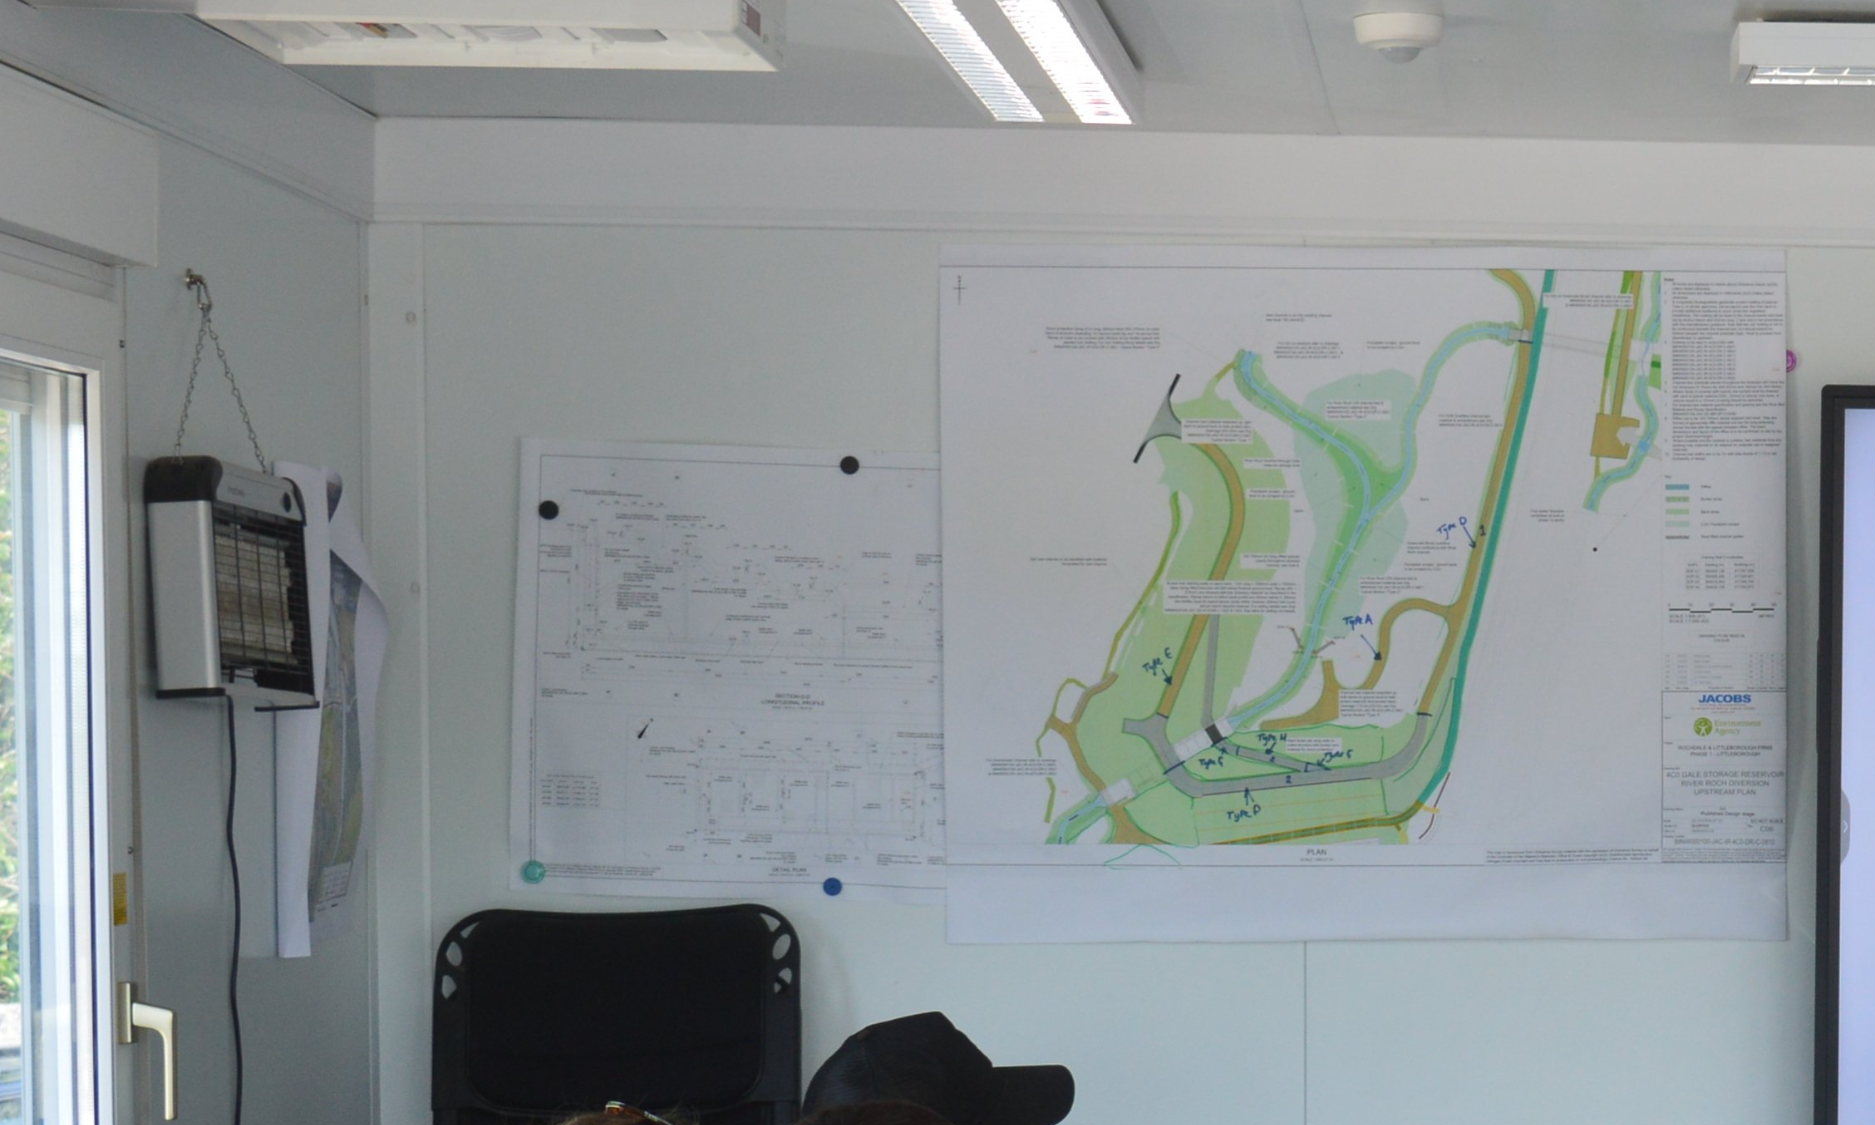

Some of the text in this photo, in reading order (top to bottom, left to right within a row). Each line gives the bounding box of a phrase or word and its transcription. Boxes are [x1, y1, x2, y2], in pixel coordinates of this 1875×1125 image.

[1365, 613, 1374, 625] A
[1698, 694, 1752, 703] JACOBS
[1714, 728, 1740, 736] Agency
